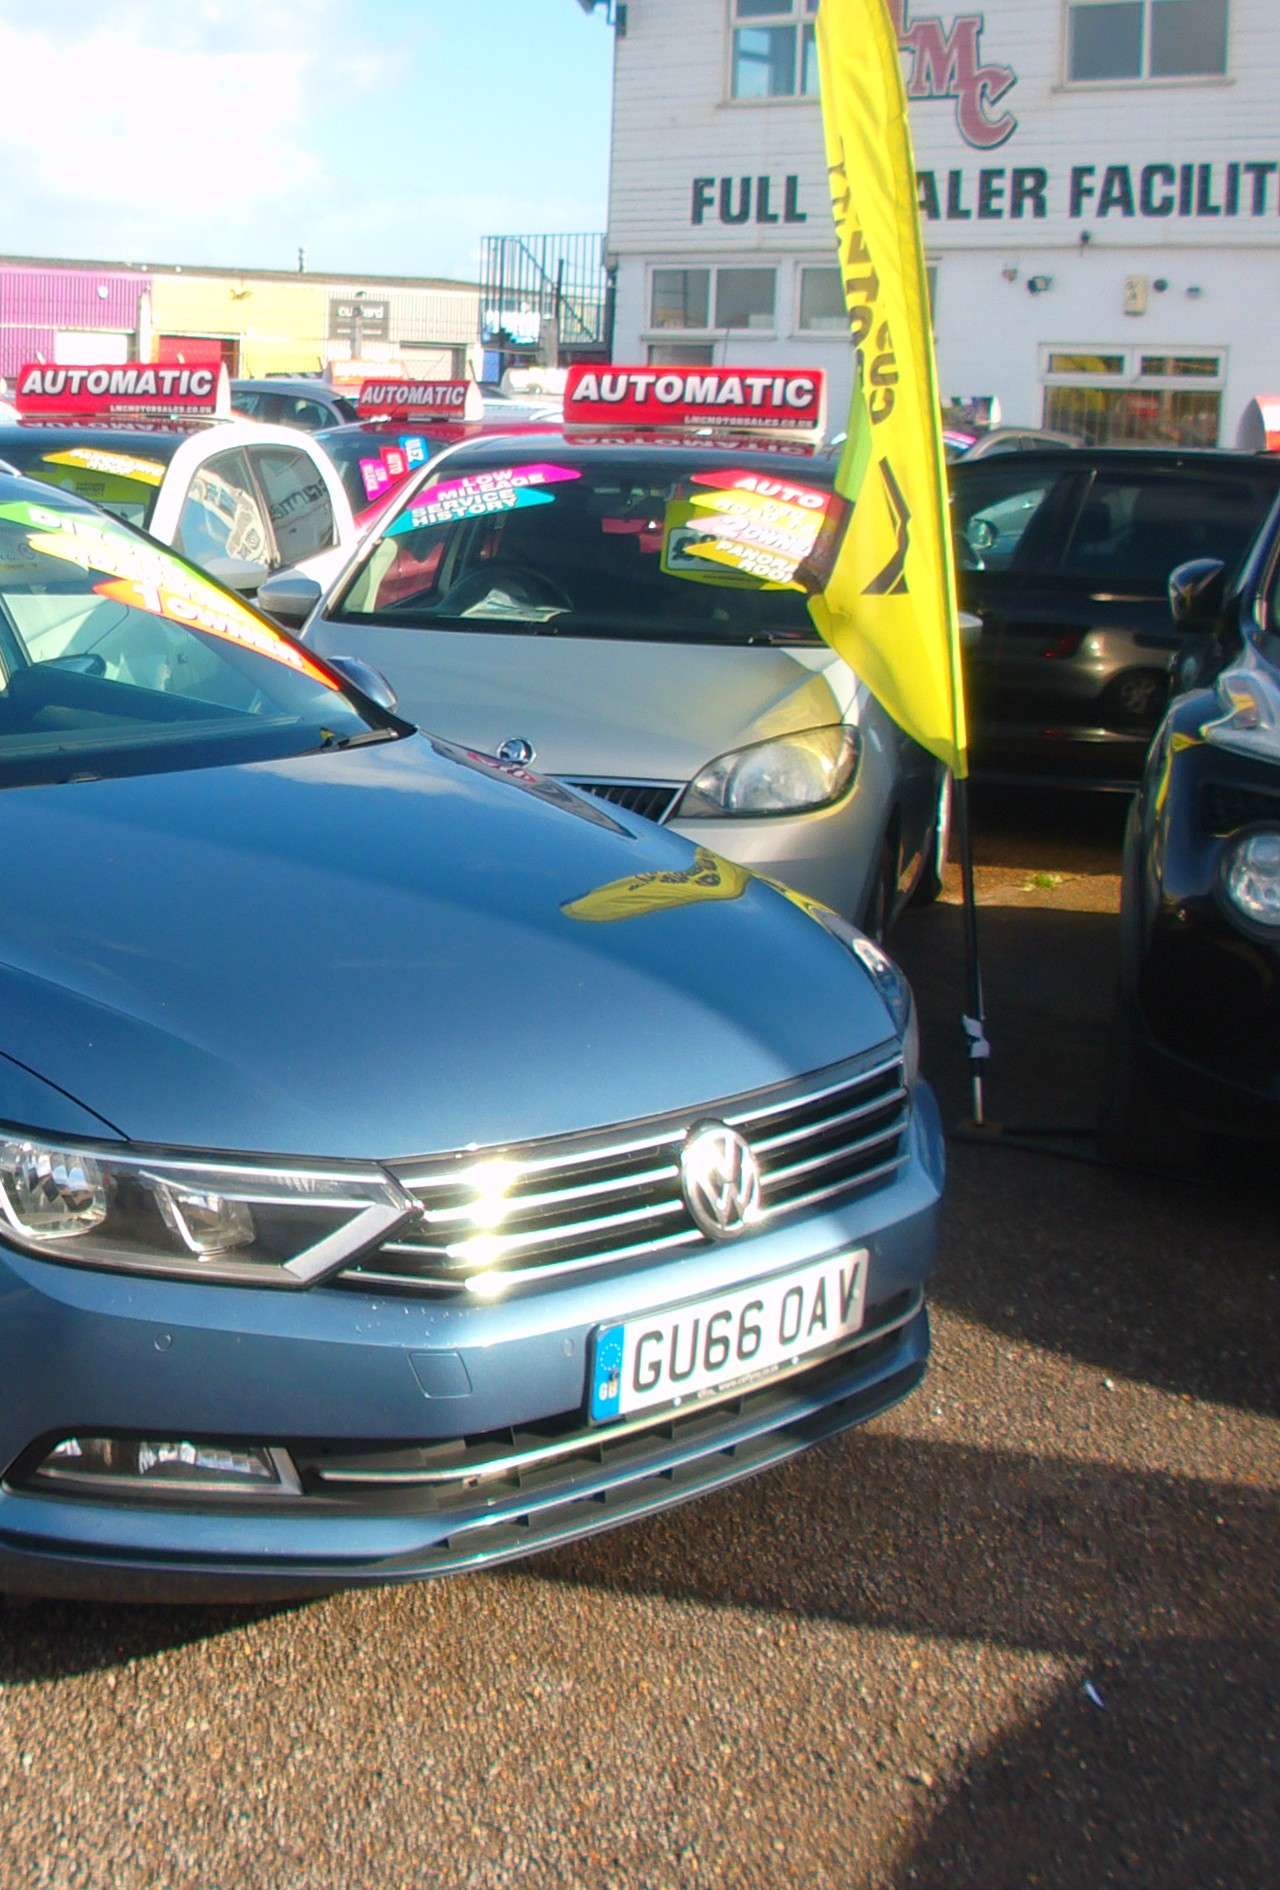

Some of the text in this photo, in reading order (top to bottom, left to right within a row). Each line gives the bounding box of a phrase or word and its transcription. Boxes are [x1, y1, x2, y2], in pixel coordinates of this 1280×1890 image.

[691, 160, 1280, 226] FULL ALER FACILIT
[22, 369, 214, 396] AUTOMATIC
[360, 385, 466, 405] AUTOMATIC
[571, 373, 814, 408] AUTOMATIC
[437, 473, 546, 502] MILEAGE
[461, 470, 513, 488] LOW
[732, 475, 825, 509] AUTO
[412, 487, 516, 519] SERVICE
[412, 495, 518, 528] HISTORY
[632, 1299, 764, 1395] GU66
[777, 1259, 862, 1348] OAV
